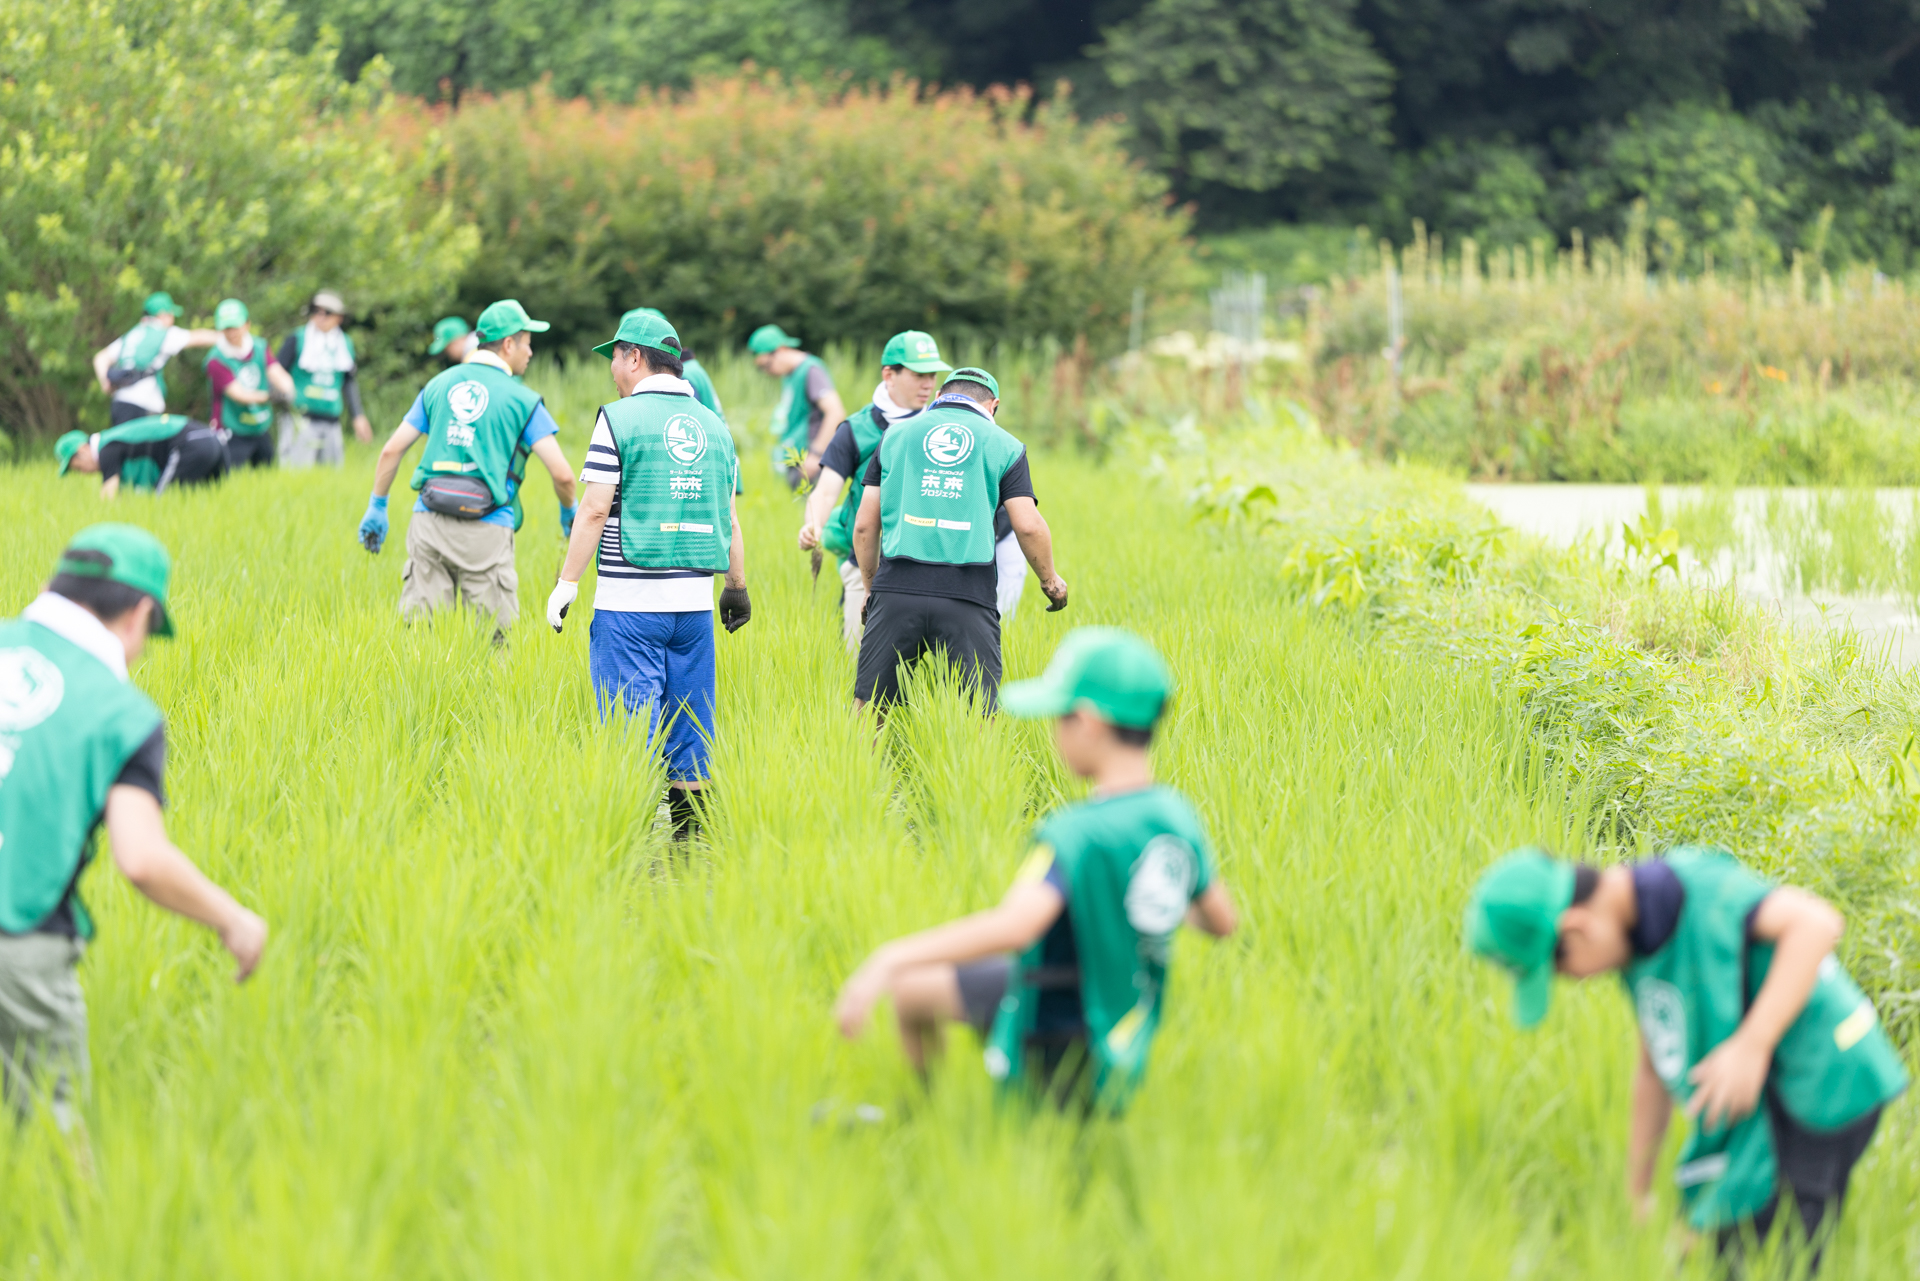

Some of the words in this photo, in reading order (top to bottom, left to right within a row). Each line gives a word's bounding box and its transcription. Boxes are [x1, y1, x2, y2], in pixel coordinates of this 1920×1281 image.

[669, 476, 703, 491] 未来
[921, 474, 963, 491] 未来
[920, 488, 962, 500] プロジェクト
